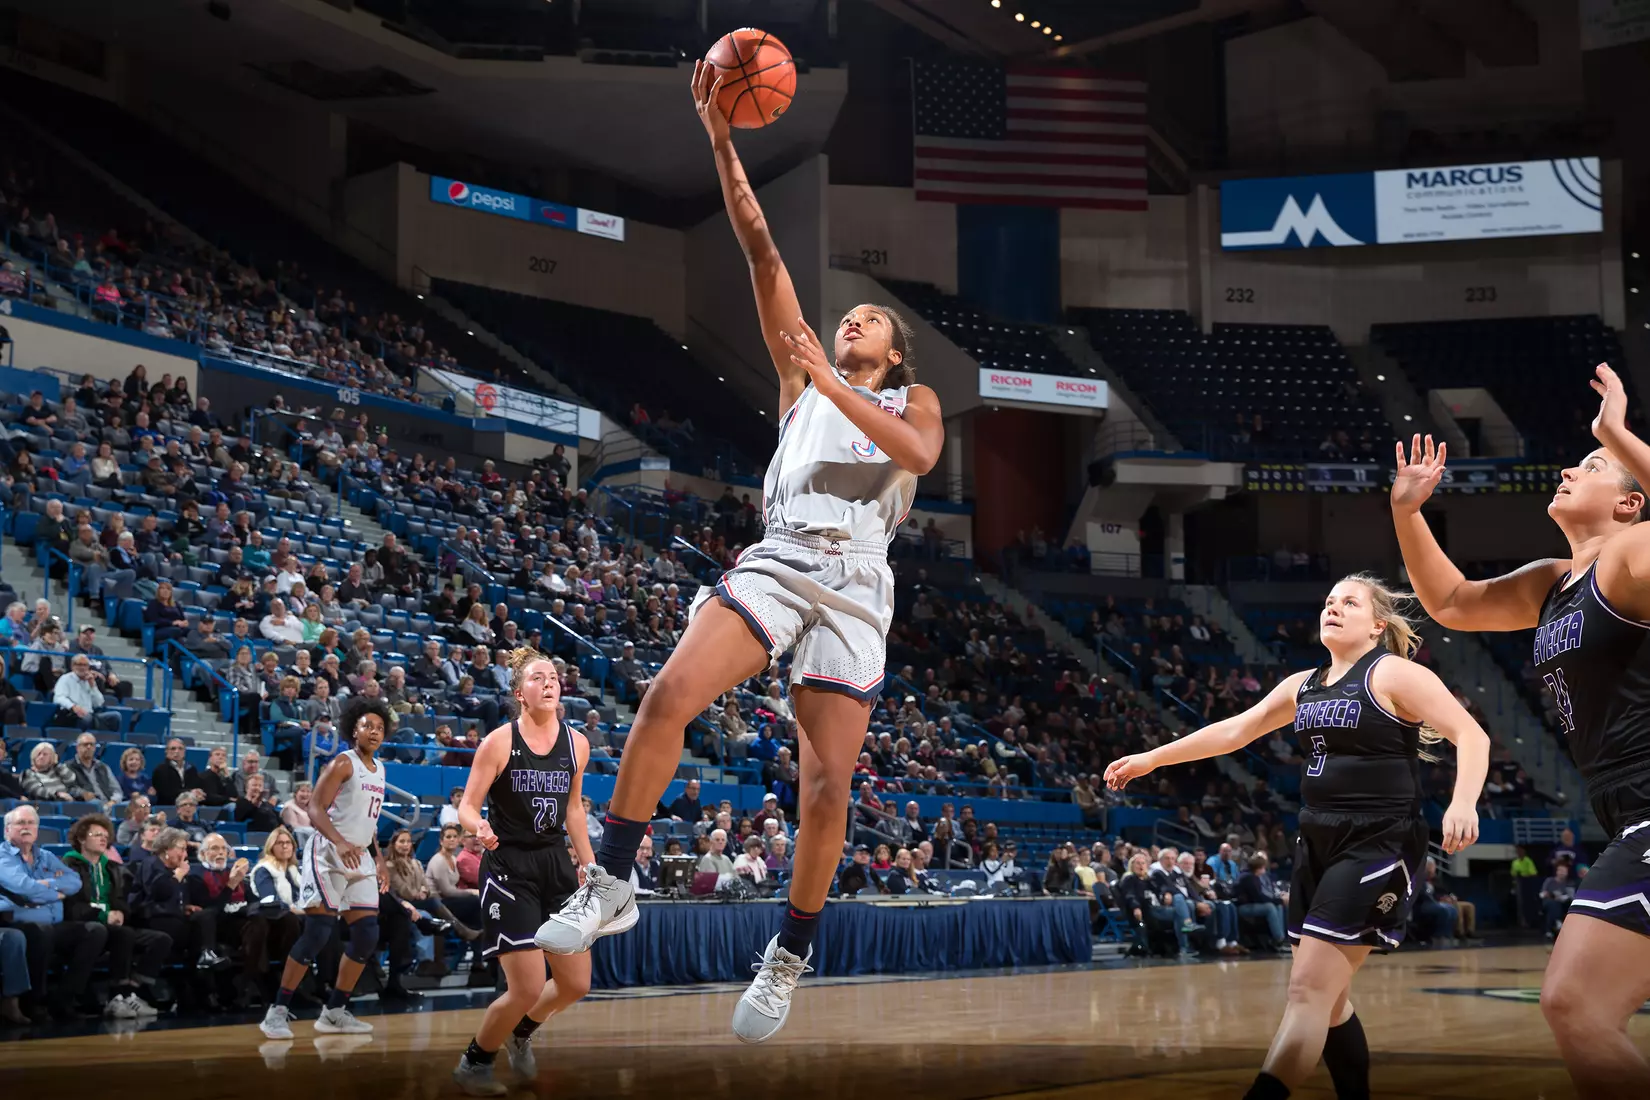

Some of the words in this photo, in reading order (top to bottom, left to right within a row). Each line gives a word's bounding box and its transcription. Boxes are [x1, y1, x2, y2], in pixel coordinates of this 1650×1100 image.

[1406, 165, 1523, 189] MARCUS
[1406, 186, 1524, 199] communications
[472, 191, 516, 211] pepsi
[529, 256, 557, 274] 207
[861, 249, 888, 265] 231
[1225, 287, 1255, 303] 232
[1464, 286, 1498, 302] 233
[991, 374, 1033, 387] RICOH
[1055, 381, 1097, 393] RICOH
[337, 389, 360, 405] 105
[1101, 523, 1121, 534] 107
[1307, 735, 1327, 776] 5
[511, 769, 570, 793] TREVECCA
[368, 796, 381, 818] 13
[532, 797, 557, 833] 23
